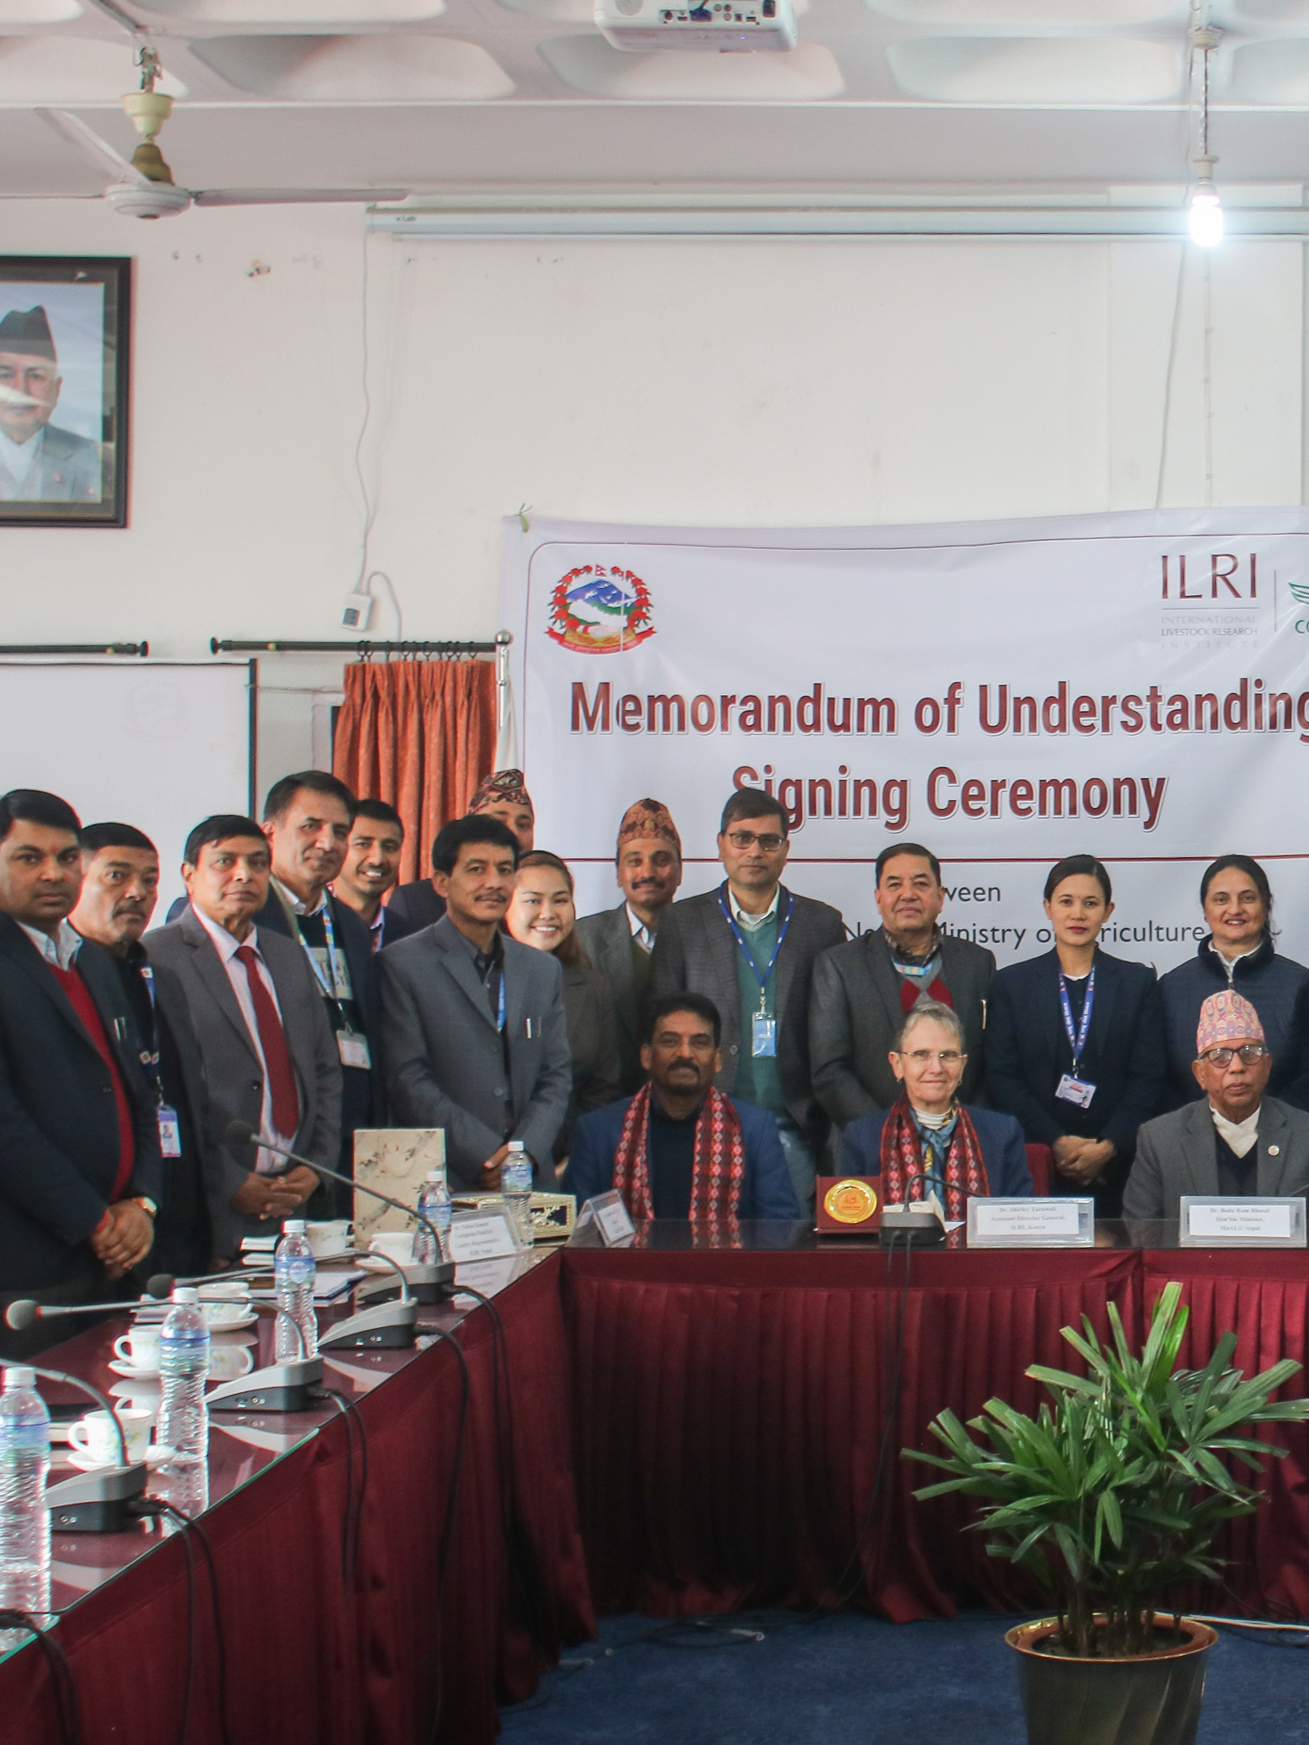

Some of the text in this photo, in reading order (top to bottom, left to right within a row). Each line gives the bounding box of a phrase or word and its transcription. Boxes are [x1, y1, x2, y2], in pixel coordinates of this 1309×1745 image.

[1161, 552, 1257, 600] ILRI
[1160, 615, 1256, 625] INTERNATIONAL
[1160, 627, 1258, 637] LIVESTOCK RESEARCH
[571, 681, 896, 736] Memorandum
[914, 681, 964, 736] of
[926, 766, 1168, 832] Ceremony
[1101, 920, 1205, 942] riculture
